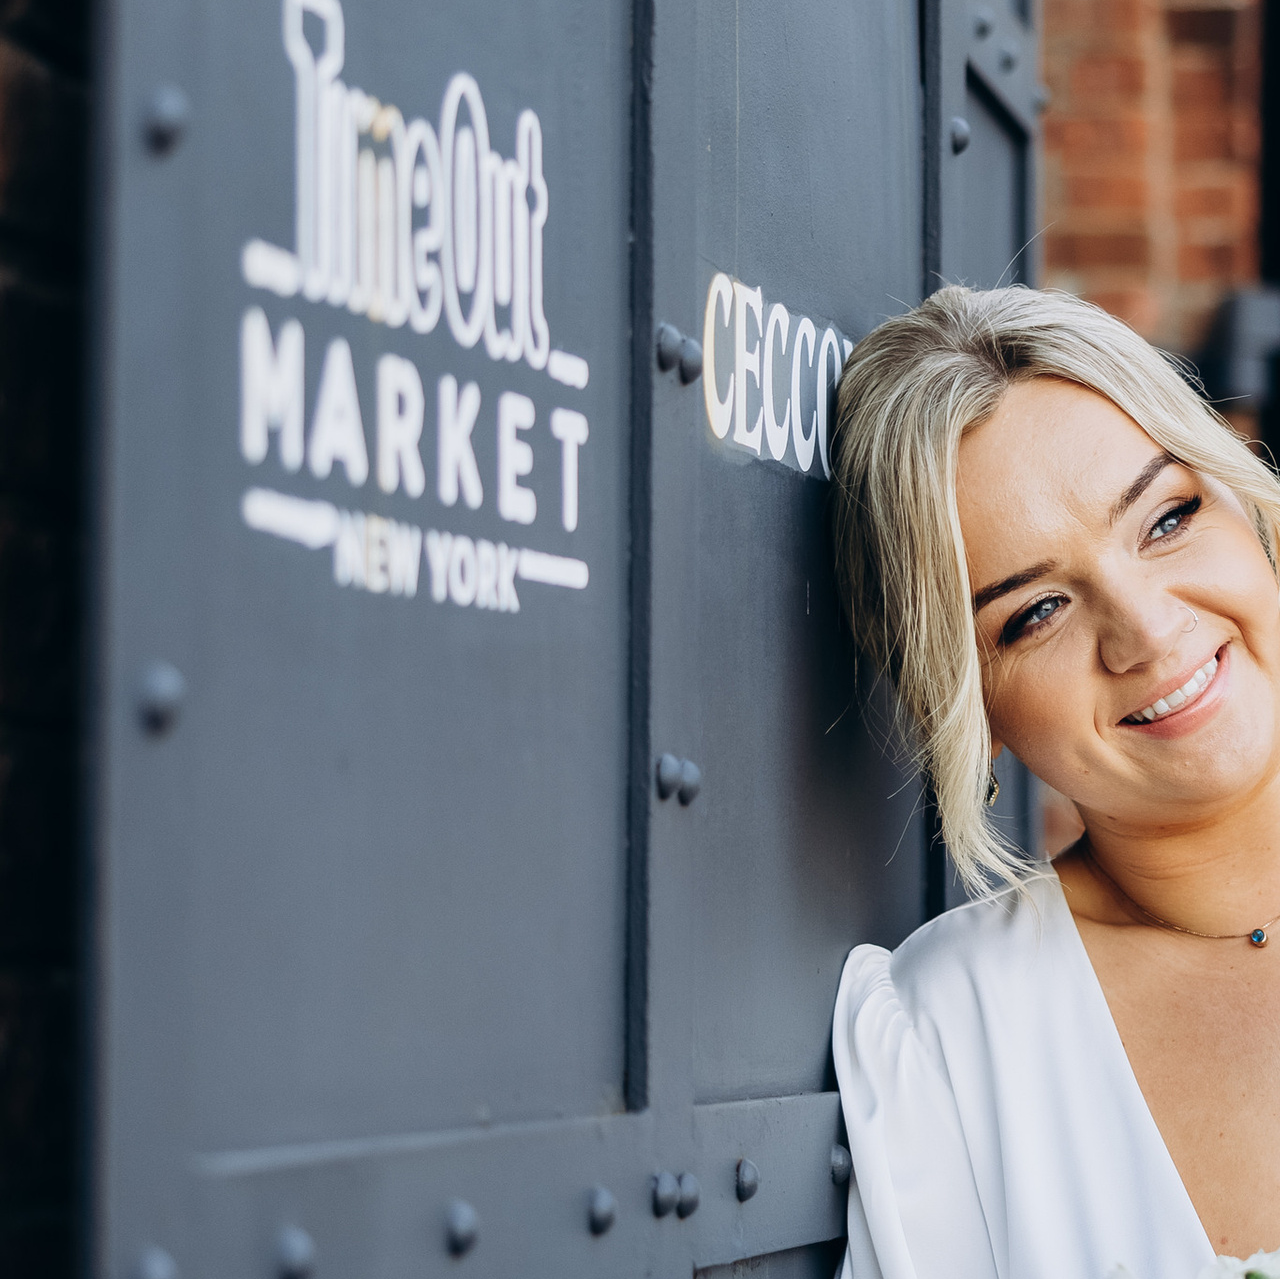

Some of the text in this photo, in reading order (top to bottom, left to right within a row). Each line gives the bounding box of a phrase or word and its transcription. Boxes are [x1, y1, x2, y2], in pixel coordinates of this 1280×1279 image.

[240, 308, 588, 531] MARKET
[702, 272, 854, 481] CECCO
[333, 509, 520, 613] NEW YORK
